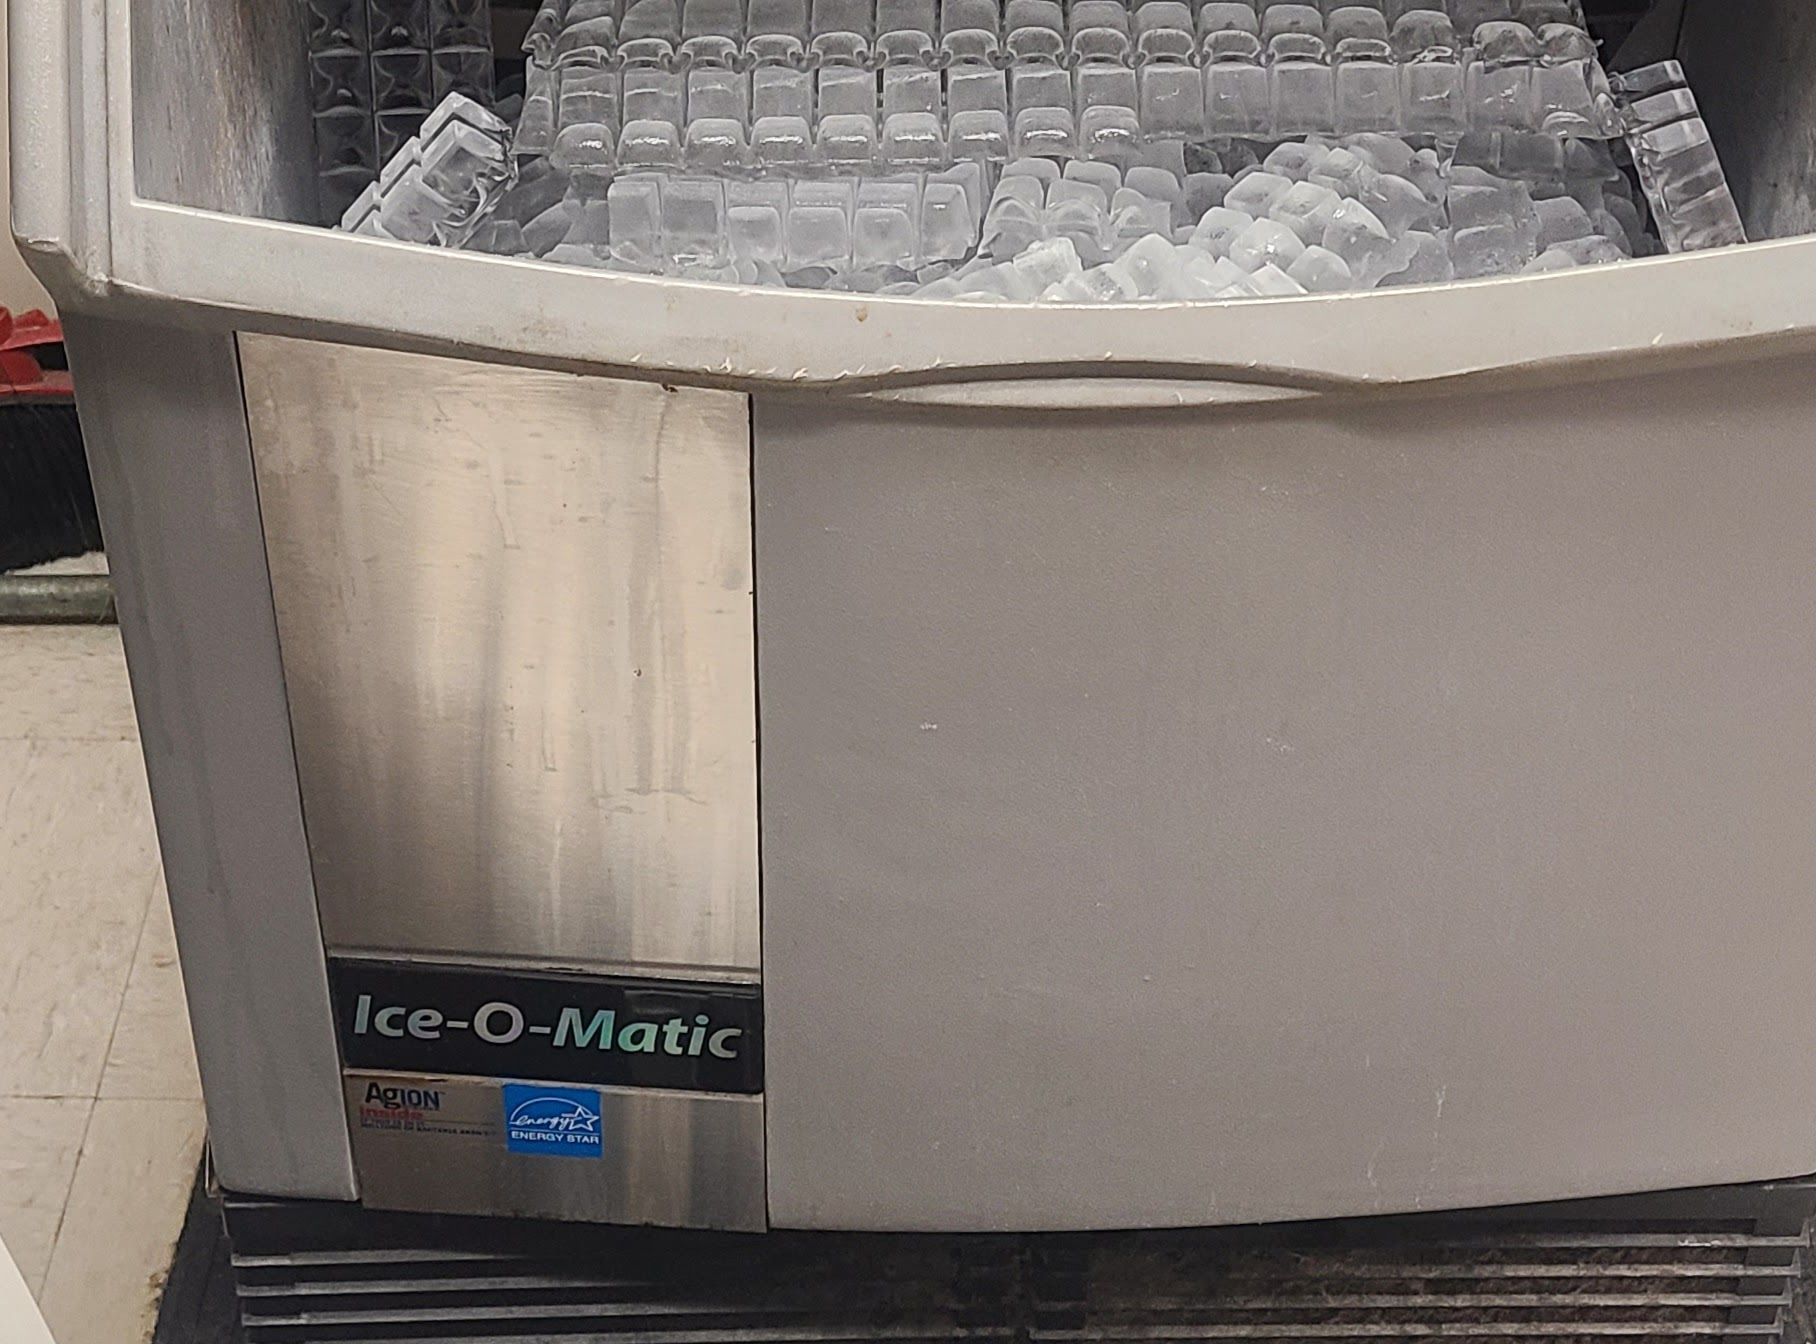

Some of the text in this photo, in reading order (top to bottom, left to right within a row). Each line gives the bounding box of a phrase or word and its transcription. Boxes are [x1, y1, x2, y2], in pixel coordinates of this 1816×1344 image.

[353, 994, 743, 1059] Ice-O-Matic
[510, 1131, 600, 1144] ENERGY STAR
